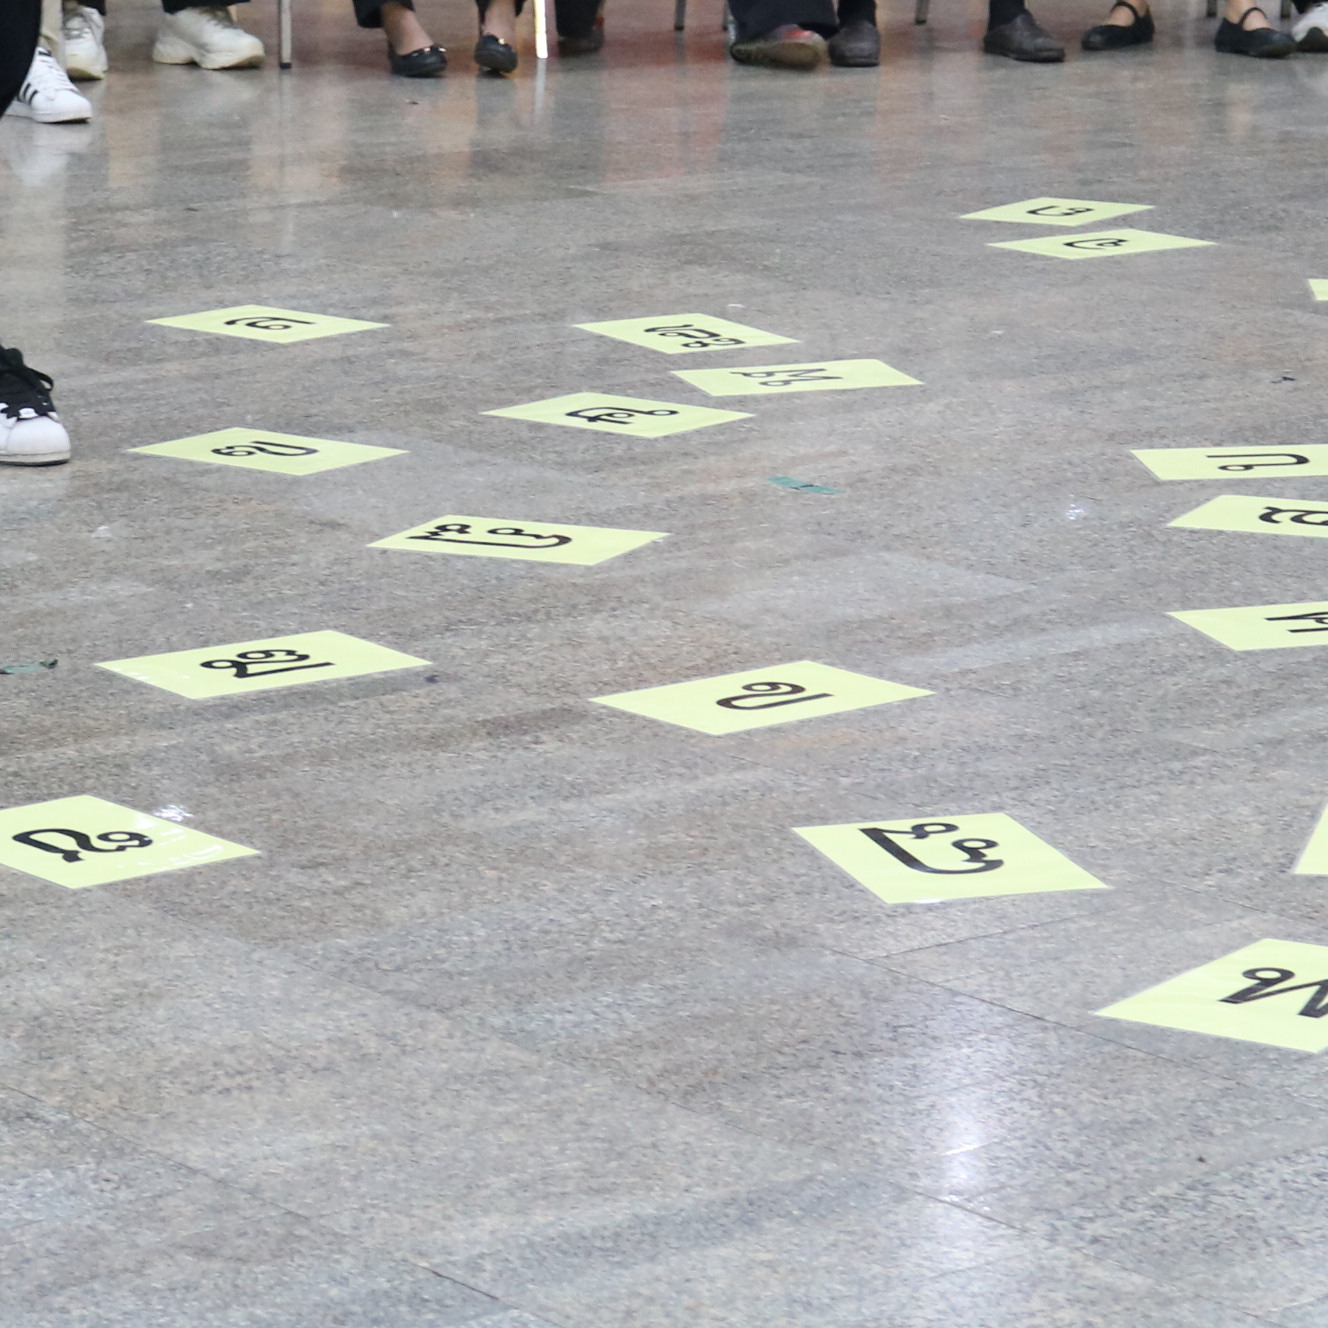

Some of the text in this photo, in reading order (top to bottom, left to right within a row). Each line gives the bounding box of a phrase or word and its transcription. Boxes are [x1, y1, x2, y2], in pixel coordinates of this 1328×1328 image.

[1062, 237, 1129, 250] จ
[223, 316, 315, 331] ล
[643, 323, 746, 349] ฐ
[729, 368, 843, 387] ฬ
[564, 406, 680, 425] ษ
[1205, 452, 1311, 472] บ
[405, 523, 573, 550] ฏ
[198, 648, 336, 680] ฆ
[715, 681, 834, 711] ข
[11, 827, 154, 864] ซ
[857, 822, 1005, 875] ฎ
